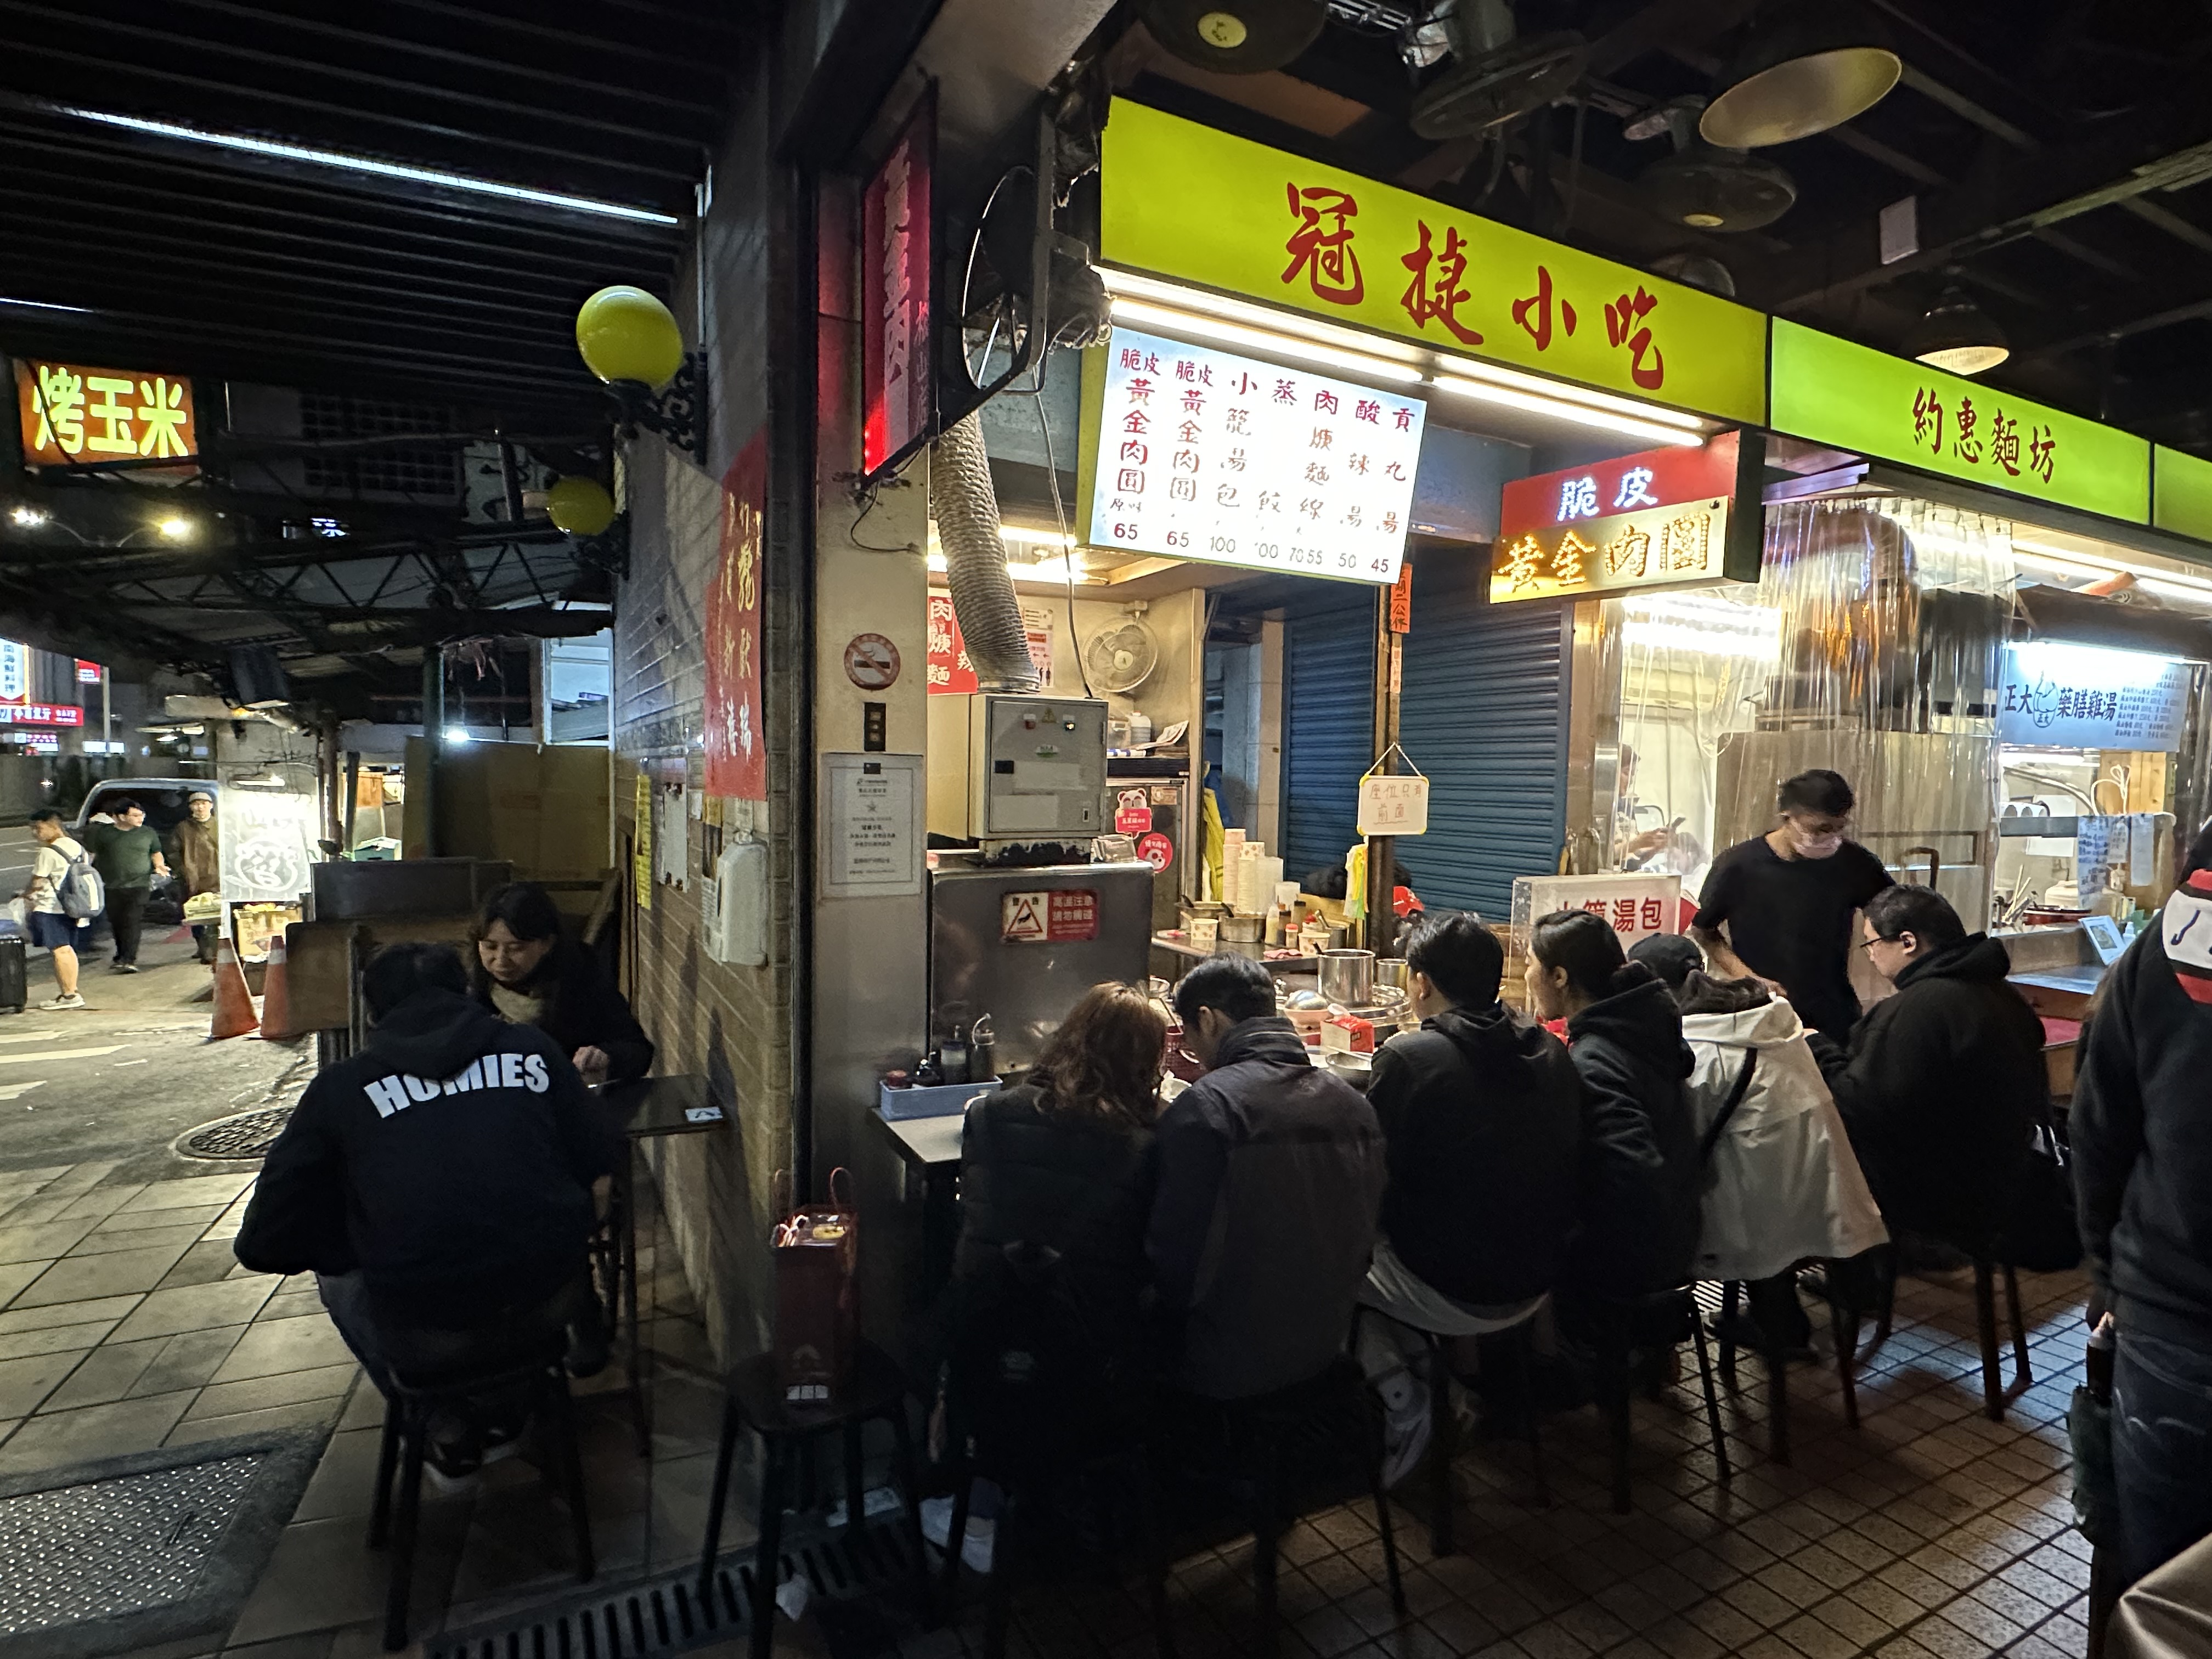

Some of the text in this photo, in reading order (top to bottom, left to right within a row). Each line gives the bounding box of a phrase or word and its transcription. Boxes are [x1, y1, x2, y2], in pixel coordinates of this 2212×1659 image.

[1281, 182, 1664, 390] 冠捷小吃
[1120, 348, 1160, 375] 脆皮
[1176, 360, 1214, 387] 脆皮
[32, 365, 189, 459] 烤玉米
[1117, 379, 1155, 494] 黃金肉圓
[1912, 387, 2056, 483] 約惠麵坊
[1377, 408, 1415, 534] 貢丸湯
[1556, 466, 1658, 522] 脆皮
[1114, 523, 1138, 540] 65
[1166, 531, 1189, 548] 65
[1210, 536, 1236, 553] 100
[1254, 542, 1278, 559] 00
[1338, 552, 1356, 568] 50
[1498, 511, 1711, 593] 黃金肉圓
[1371, 557, 1389, 573] 45
[2005, 684, 2117, 721] 正大 藥膳雞湯
[1369, 783, 1421, 799] 座位只有
[1377, 803, 1404, 822] 前面
